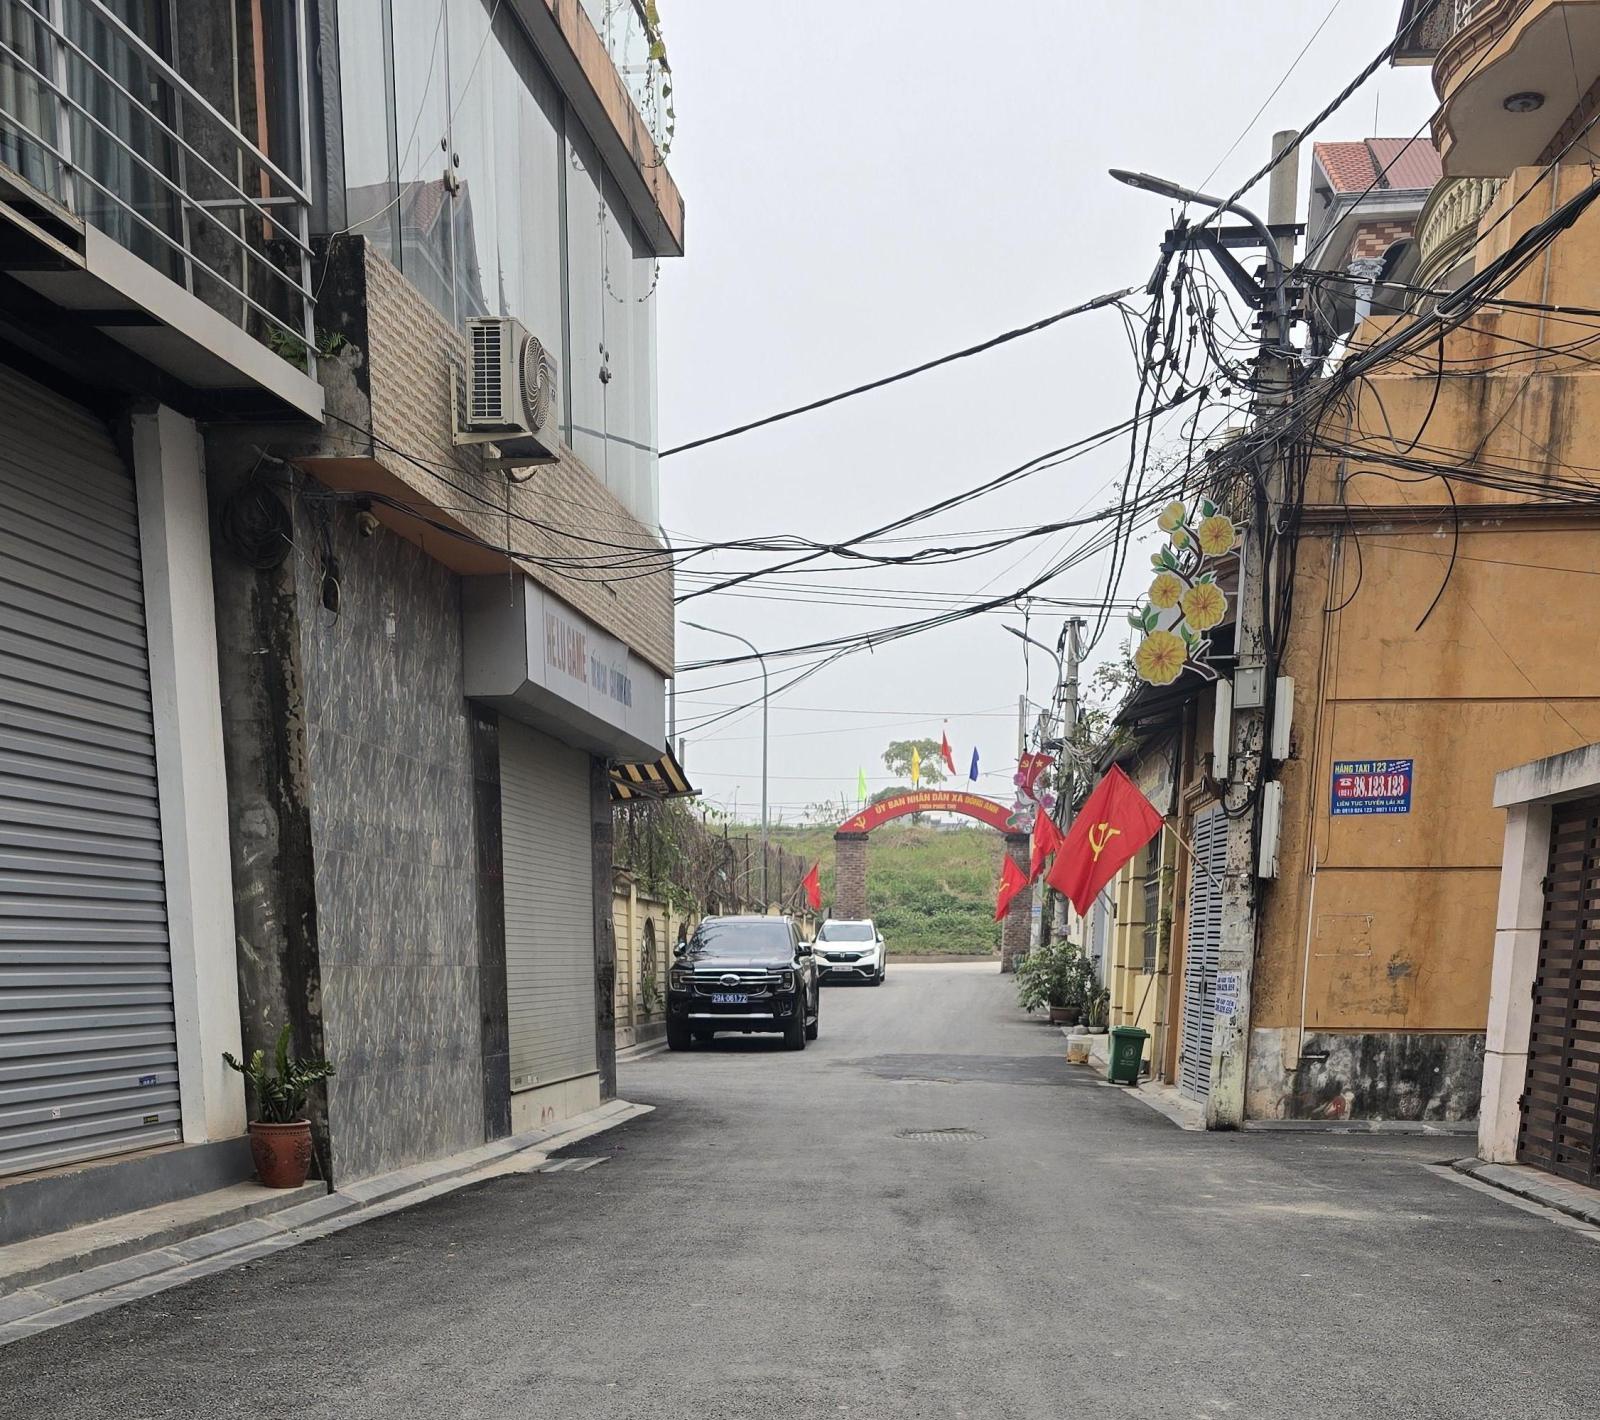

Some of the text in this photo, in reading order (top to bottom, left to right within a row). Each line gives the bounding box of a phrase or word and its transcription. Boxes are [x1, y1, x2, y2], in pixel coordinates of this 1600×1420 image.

[1355, 764, 1370, 774] TAXI
[1372, 762, 1387, 773] 123
[1353, 774, 1404, 798] 38.123.123
[888, 797, 906, 810] BAN
[907, 792, 931, 805] NHÂN
[932, 792, 950, 802] DÂN
